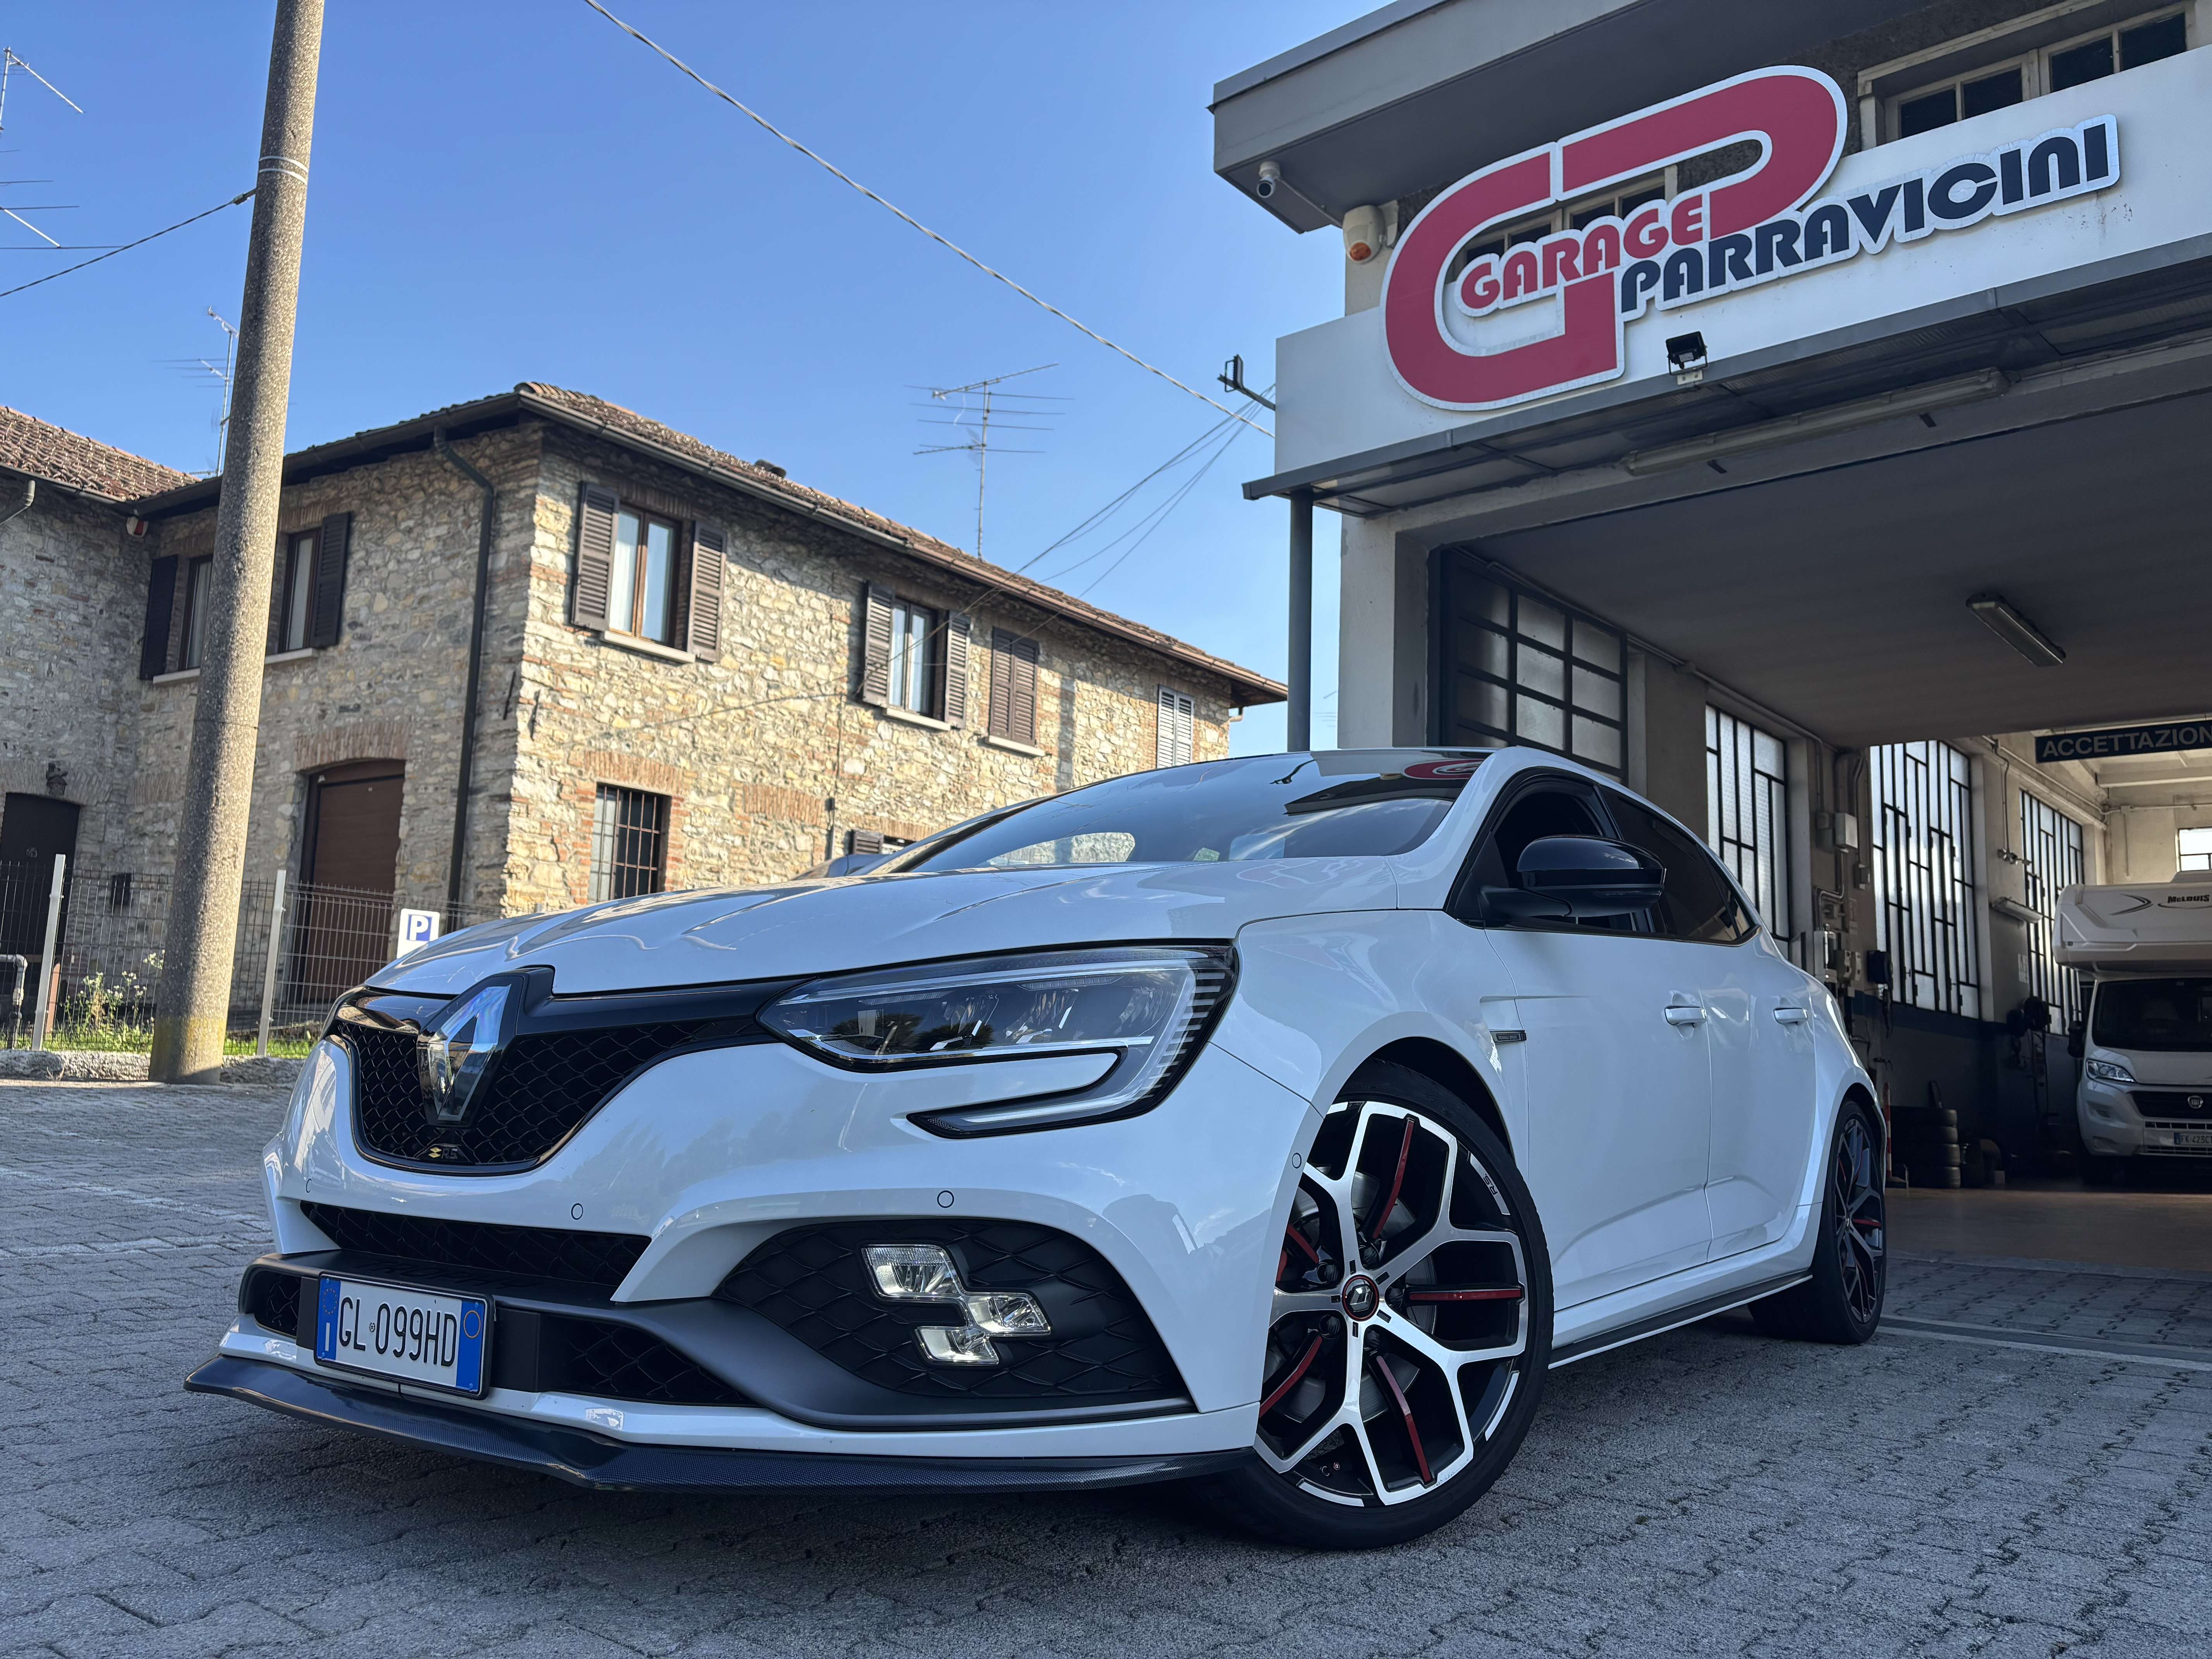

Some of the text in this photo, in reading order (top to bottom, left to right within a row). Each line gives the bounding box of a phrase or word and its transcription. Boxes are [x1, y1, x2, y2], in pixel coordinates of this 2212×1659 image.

[1621, 123, 2108, 313] PARRAVICINI
[1461, 194, 1703, 309] GARAGE
[2043, 725, 2212, 757] ACCETTAZION
[410, 915, 429, 941] P
[1483, 1173, 1498, 1195] R.S.
[339, 1297, 457, 1367] GL 099HD
